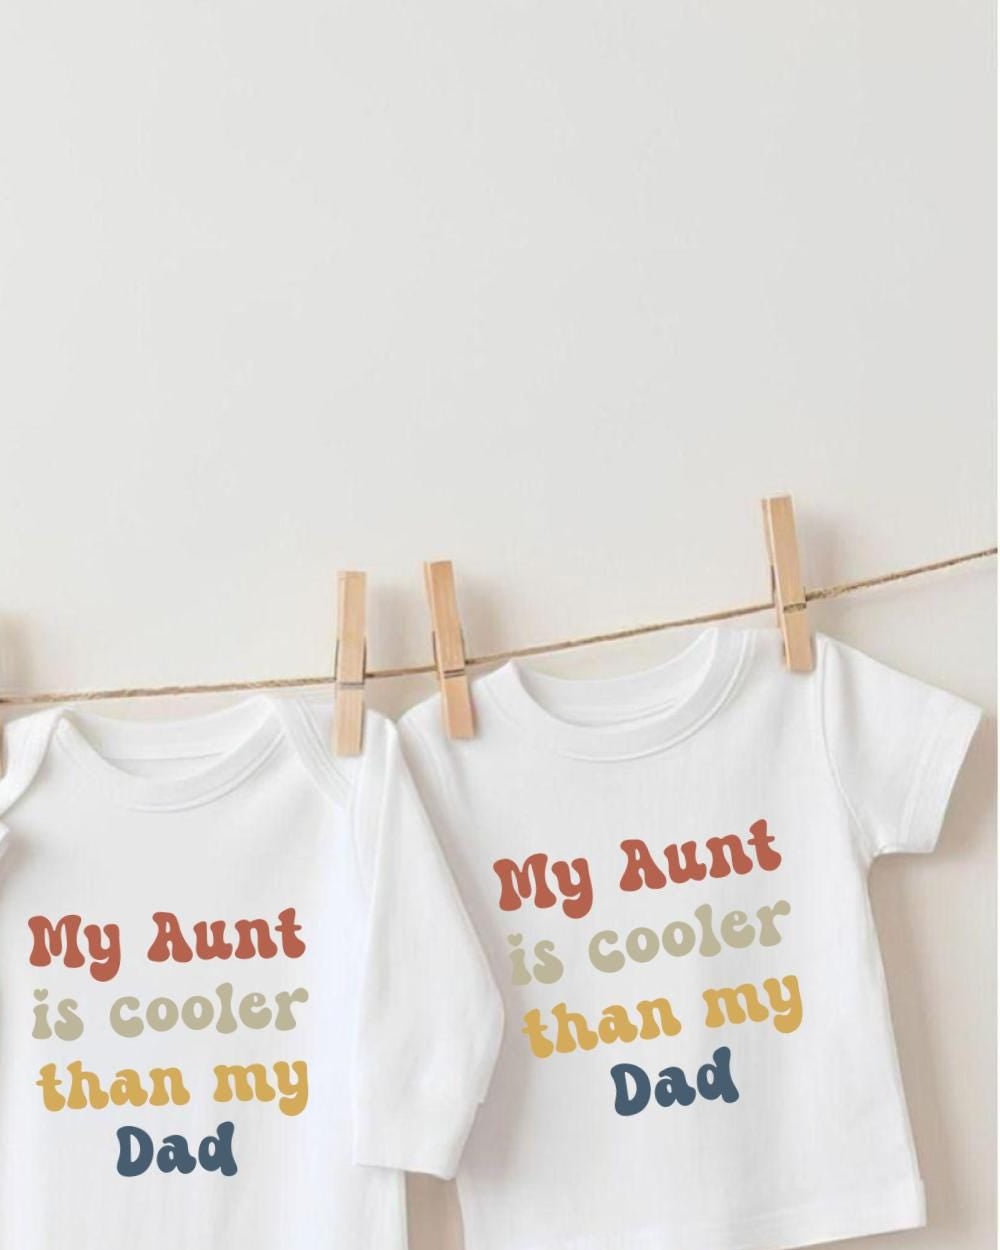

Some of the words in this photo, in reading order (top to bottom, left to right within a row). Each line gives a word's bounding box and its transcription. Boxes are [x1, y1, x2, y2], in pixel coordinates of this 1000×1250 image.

[492, 853, 594, 920] My
[619, 819, 782, 892] Aunt
[27, 914, 121, 983] My
[147, 907, 306, 963] Aunt
[507, 932, 564, 986] is
[588, 900, 791, 974] cooler
[31, 988, 84, 1042] is
[109, 982, 309, 1038] cooler
[519, 997, 682, 1060] than
[702, 974, 803, 1034] my
[35, 1060, 191, 1113] than
[212, 1060, 309, 1117] my
[610, 1046, 740, 1117] Dad
[116, 1121, 238, 1177] Dad
